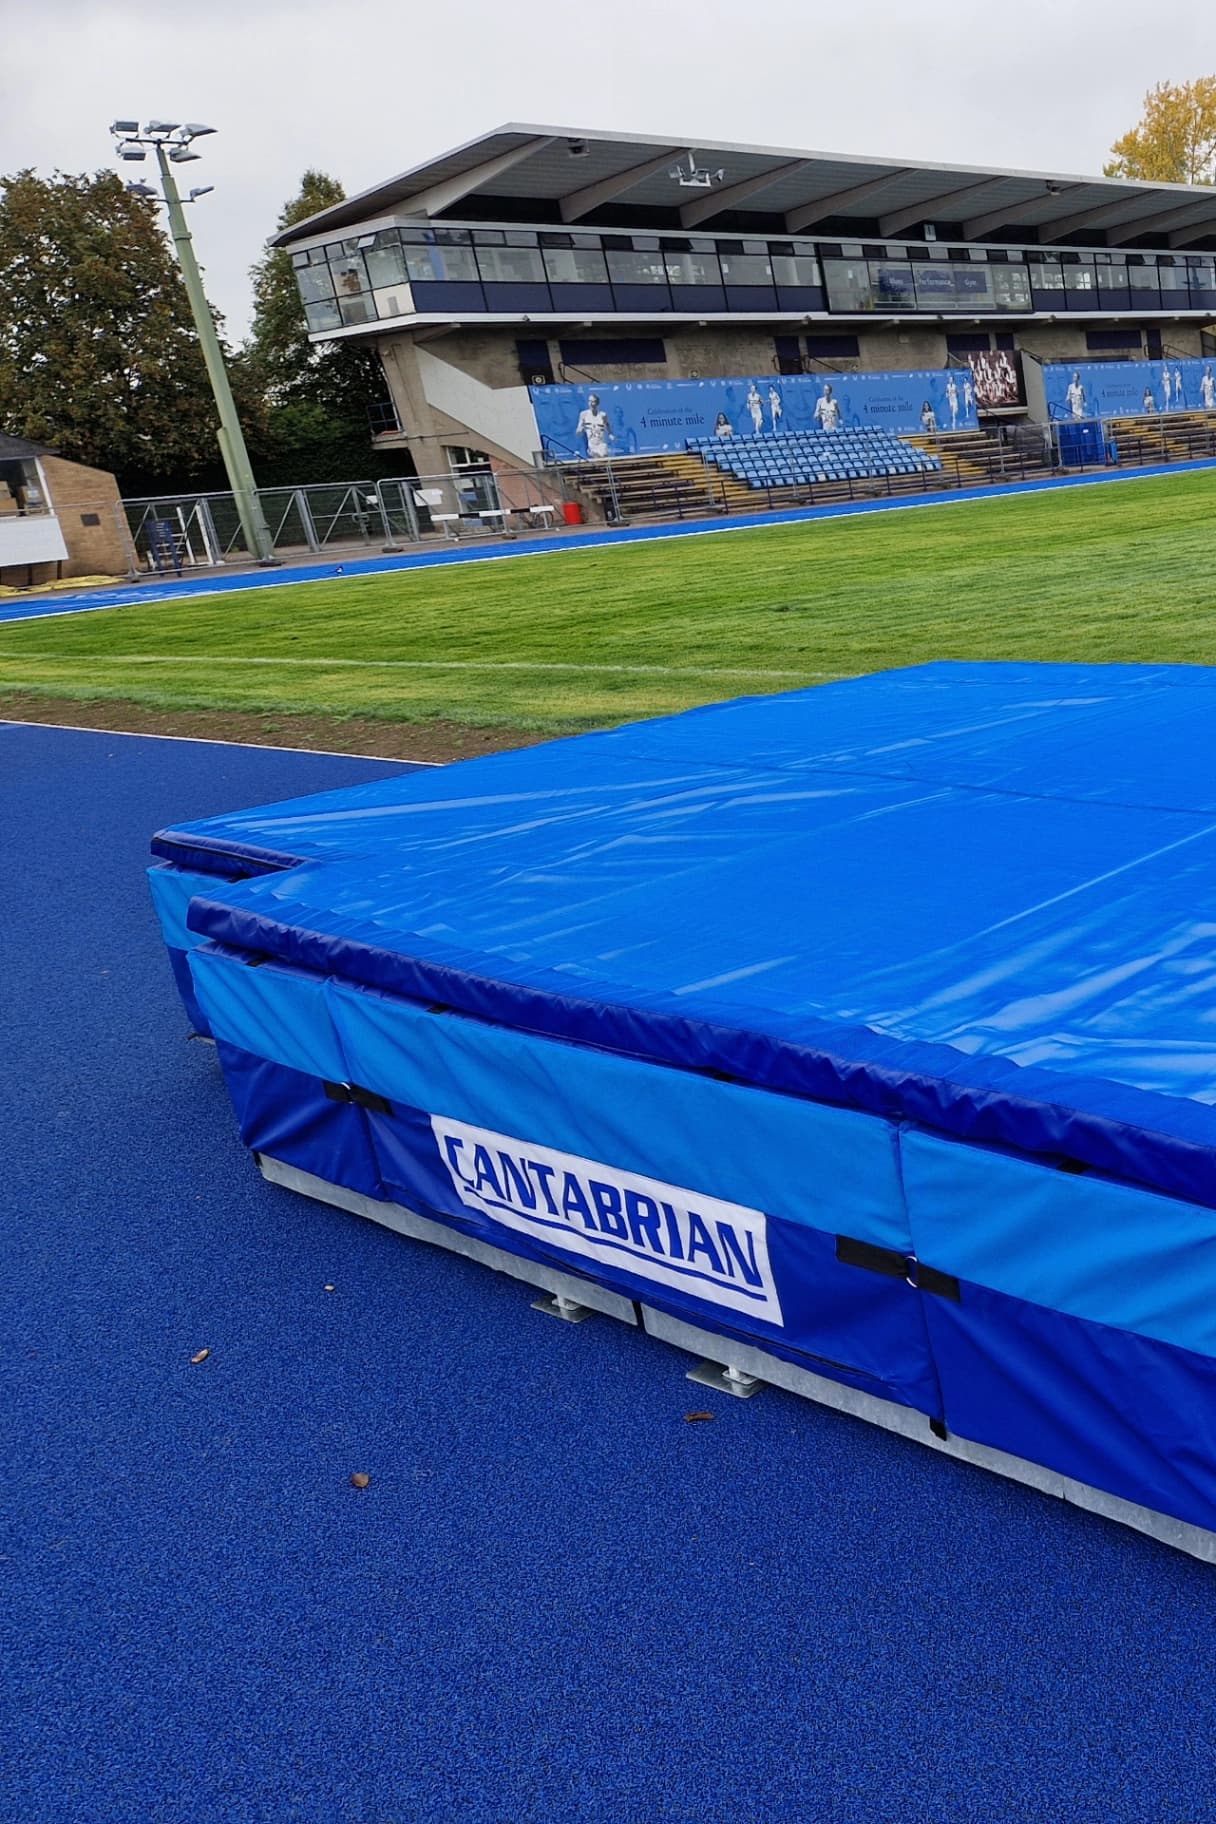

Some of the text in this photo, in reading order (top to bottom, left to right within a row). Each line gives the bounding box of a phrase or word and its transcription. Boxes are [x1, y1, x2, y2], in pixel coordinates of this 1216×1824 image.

[639, 412, 705, 429] 4 minute mile
[443, 1135, 764, 1289] CANTABRIAN
